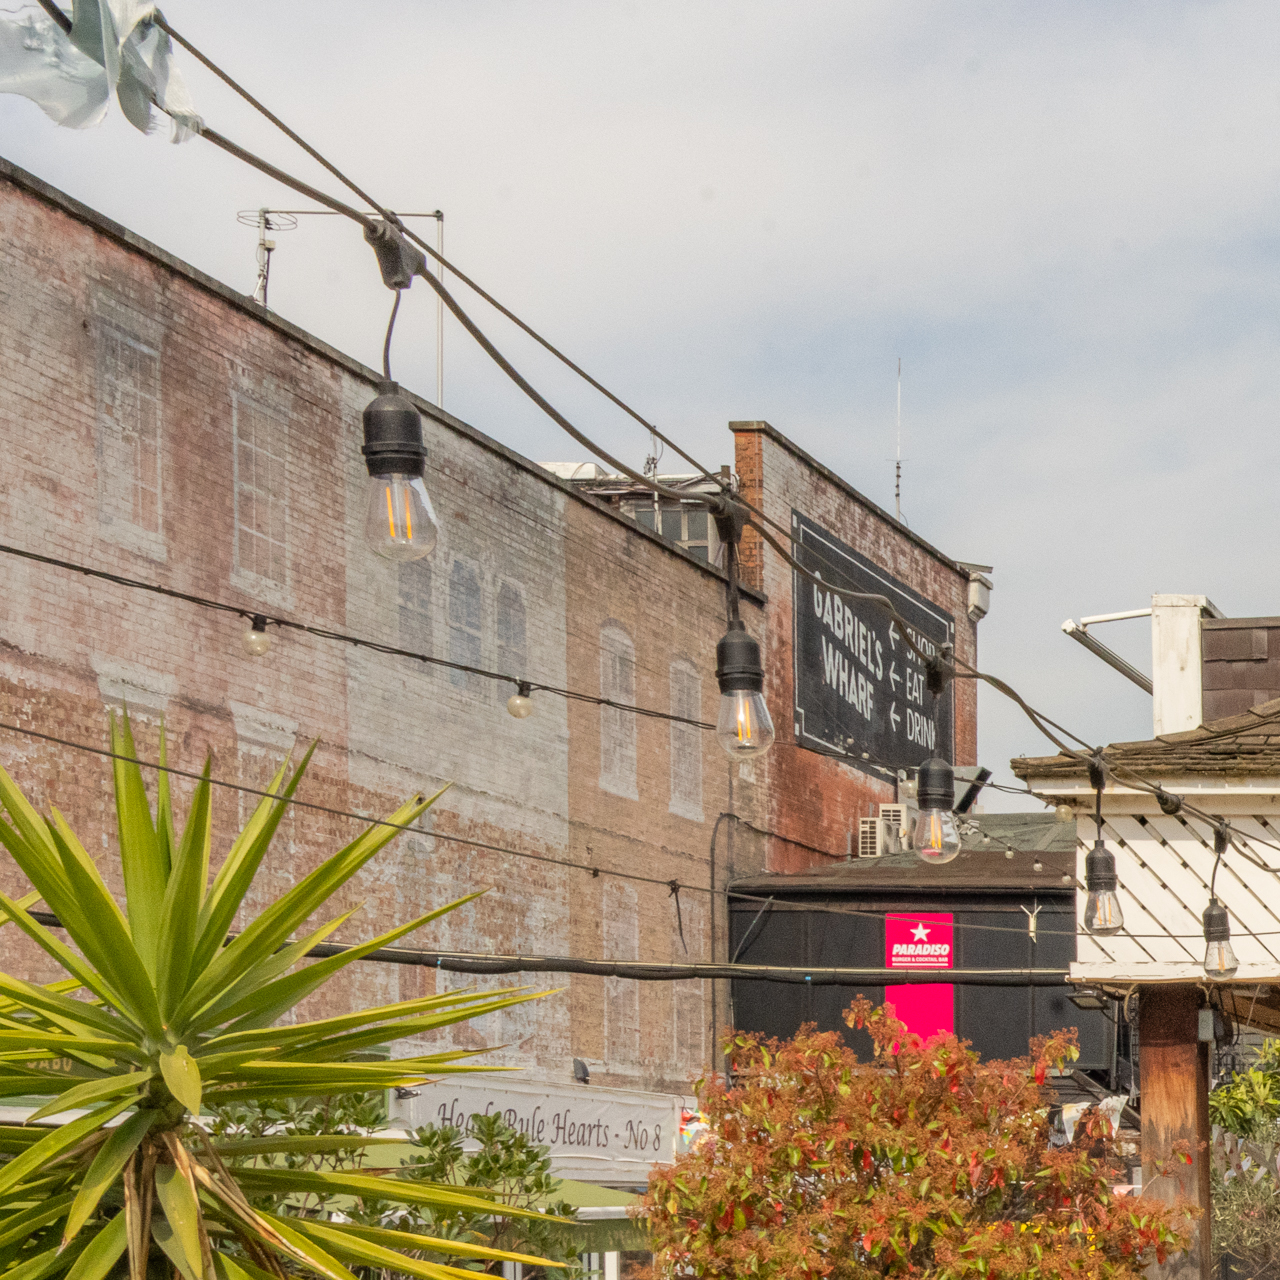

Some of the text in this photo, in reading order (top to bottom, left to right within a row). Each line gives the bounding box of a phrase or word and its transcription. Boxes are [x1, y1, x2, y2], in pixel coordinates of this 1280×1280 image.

[813, 570, 884, 681] GABRIEL'S
[821, 634, 875, 722] WHARF
[906, 667, 925, 706] EAT
[892, 944, 950, 956] PARADISO
[551, 1109, 609, 1148] Hearts
[624, 1119, 649, 1150] No
[652, 1123, 662, 1150] 8
